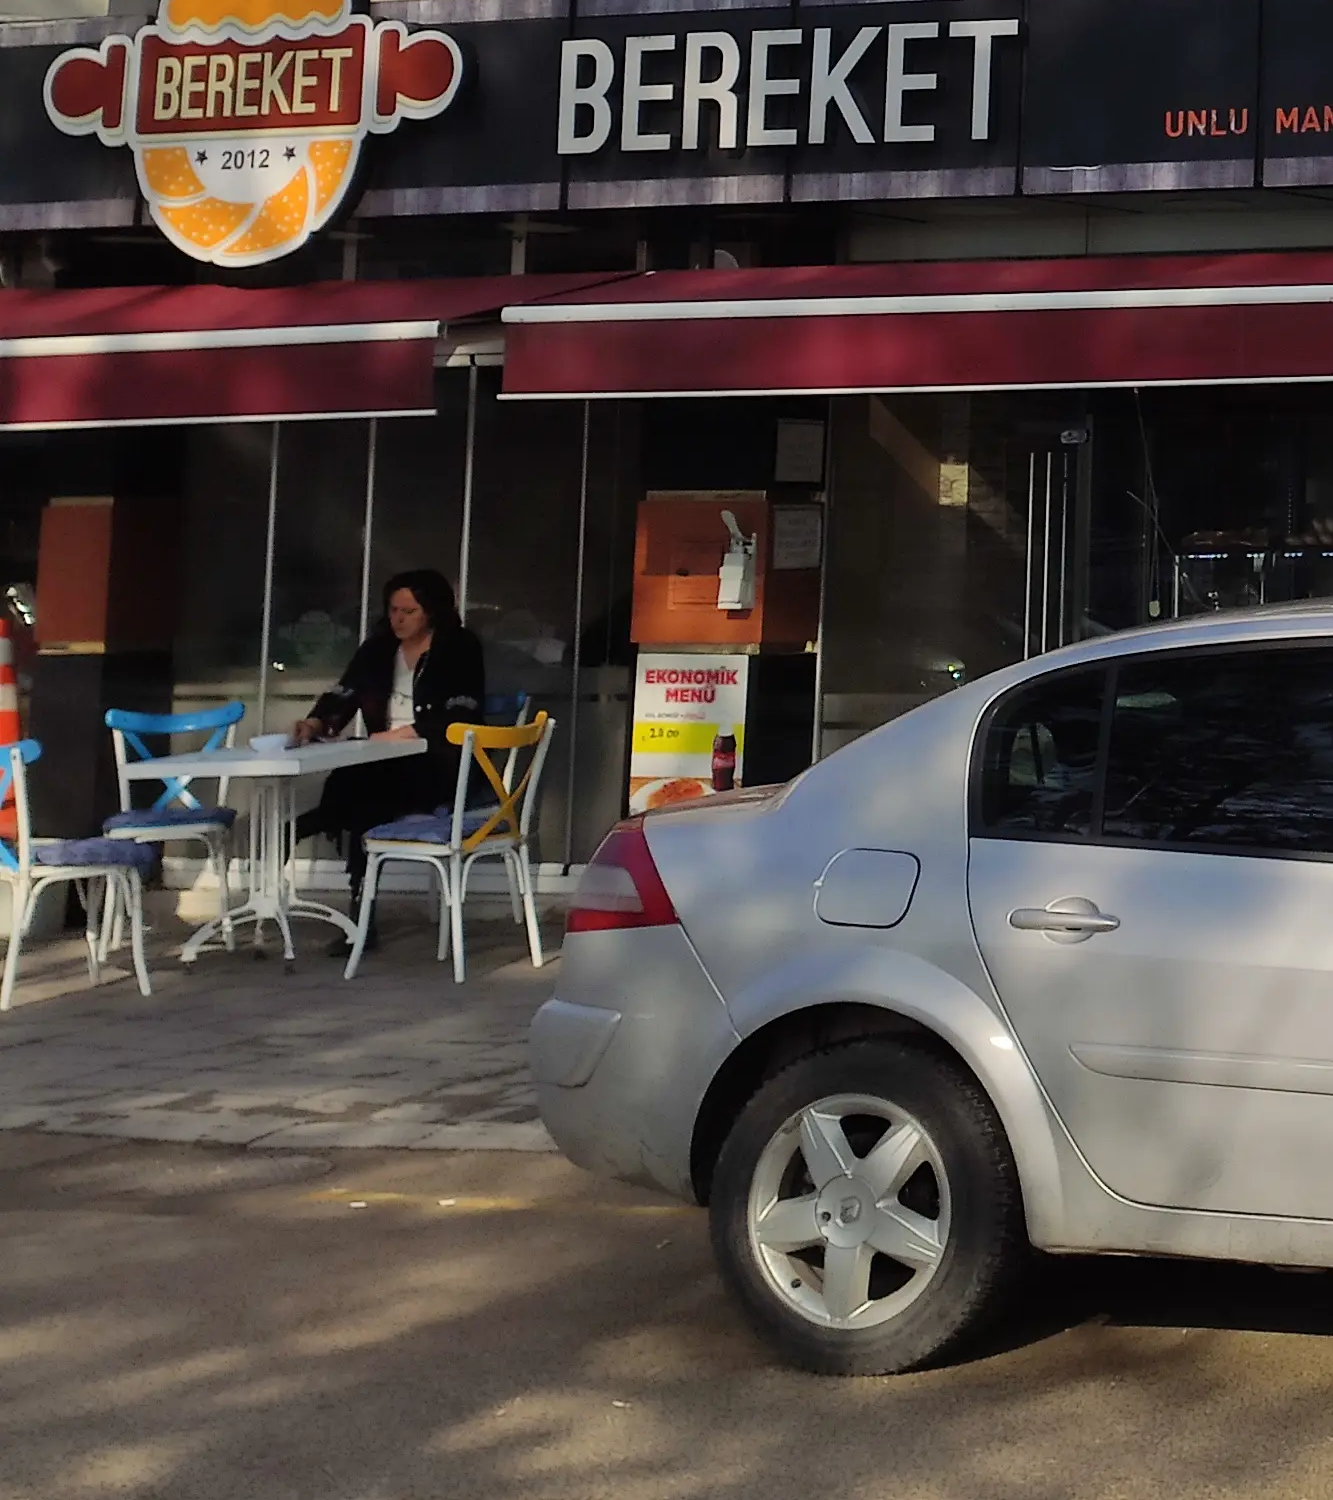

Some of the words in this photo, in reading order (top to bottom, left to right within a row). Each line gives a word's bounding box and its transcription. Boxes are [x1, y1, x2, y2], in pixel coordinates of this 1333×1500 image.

[153, 48, 354, 121] BEREKET
[556, 18, 1020, 156] BEREKET
[1164, 108, 1250, 139] UNLU
[220, 149, 271, 171] 2012
[645, 666, 739, 685] EKONOMİK
[665, 685, 716, 703] MENÜ
